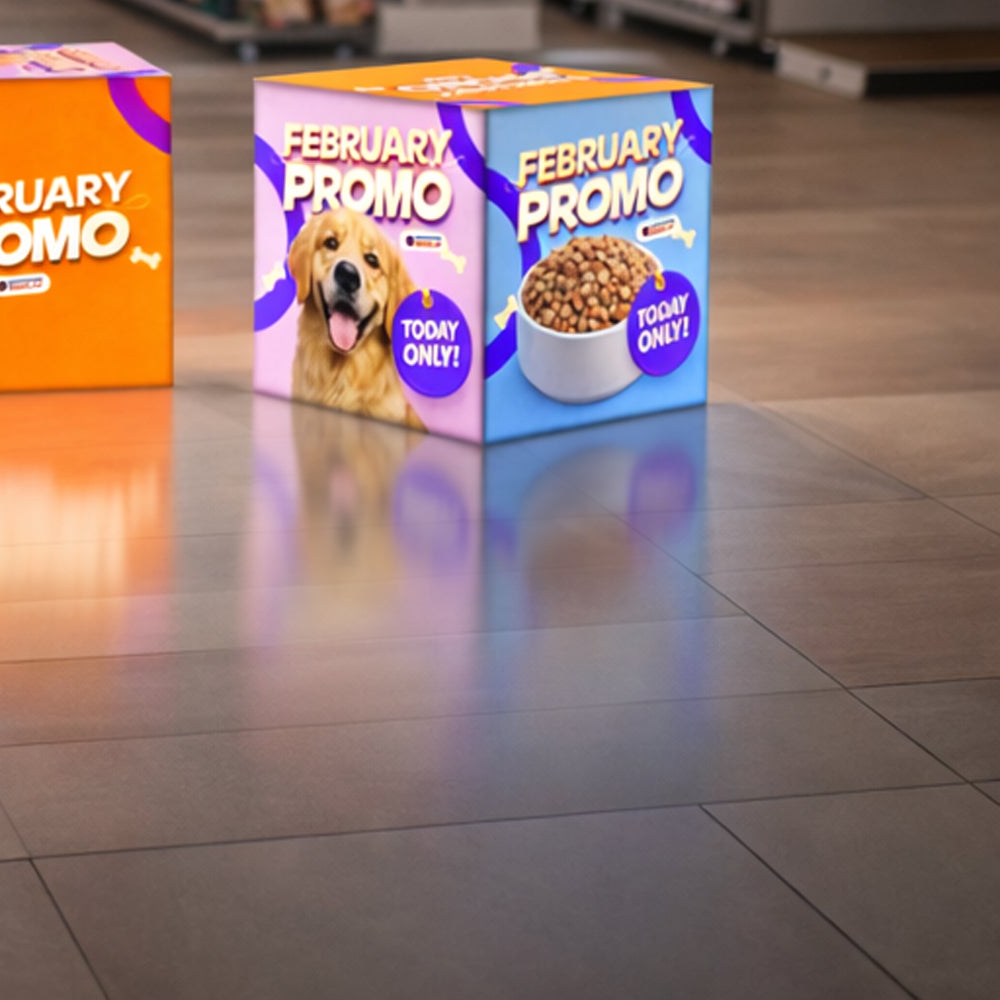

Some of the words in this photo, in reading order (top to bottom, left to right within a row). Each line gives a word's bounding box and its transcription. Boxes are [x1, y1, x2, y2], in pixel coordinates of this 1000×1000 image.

[283, 122, 452, 168] FEBRUARY
[517, 118, 685, 189] FEBRUARY
[283, 162, 453, 223] PROMO
[517, 157, 685, 243] PROMO
[401, 319, 460, 342] TODAY
[637, 292, 690, 329] TODAY
[403, 342, 460, 368] ONLY!
[637, 316, 690, 353] ONLY!
